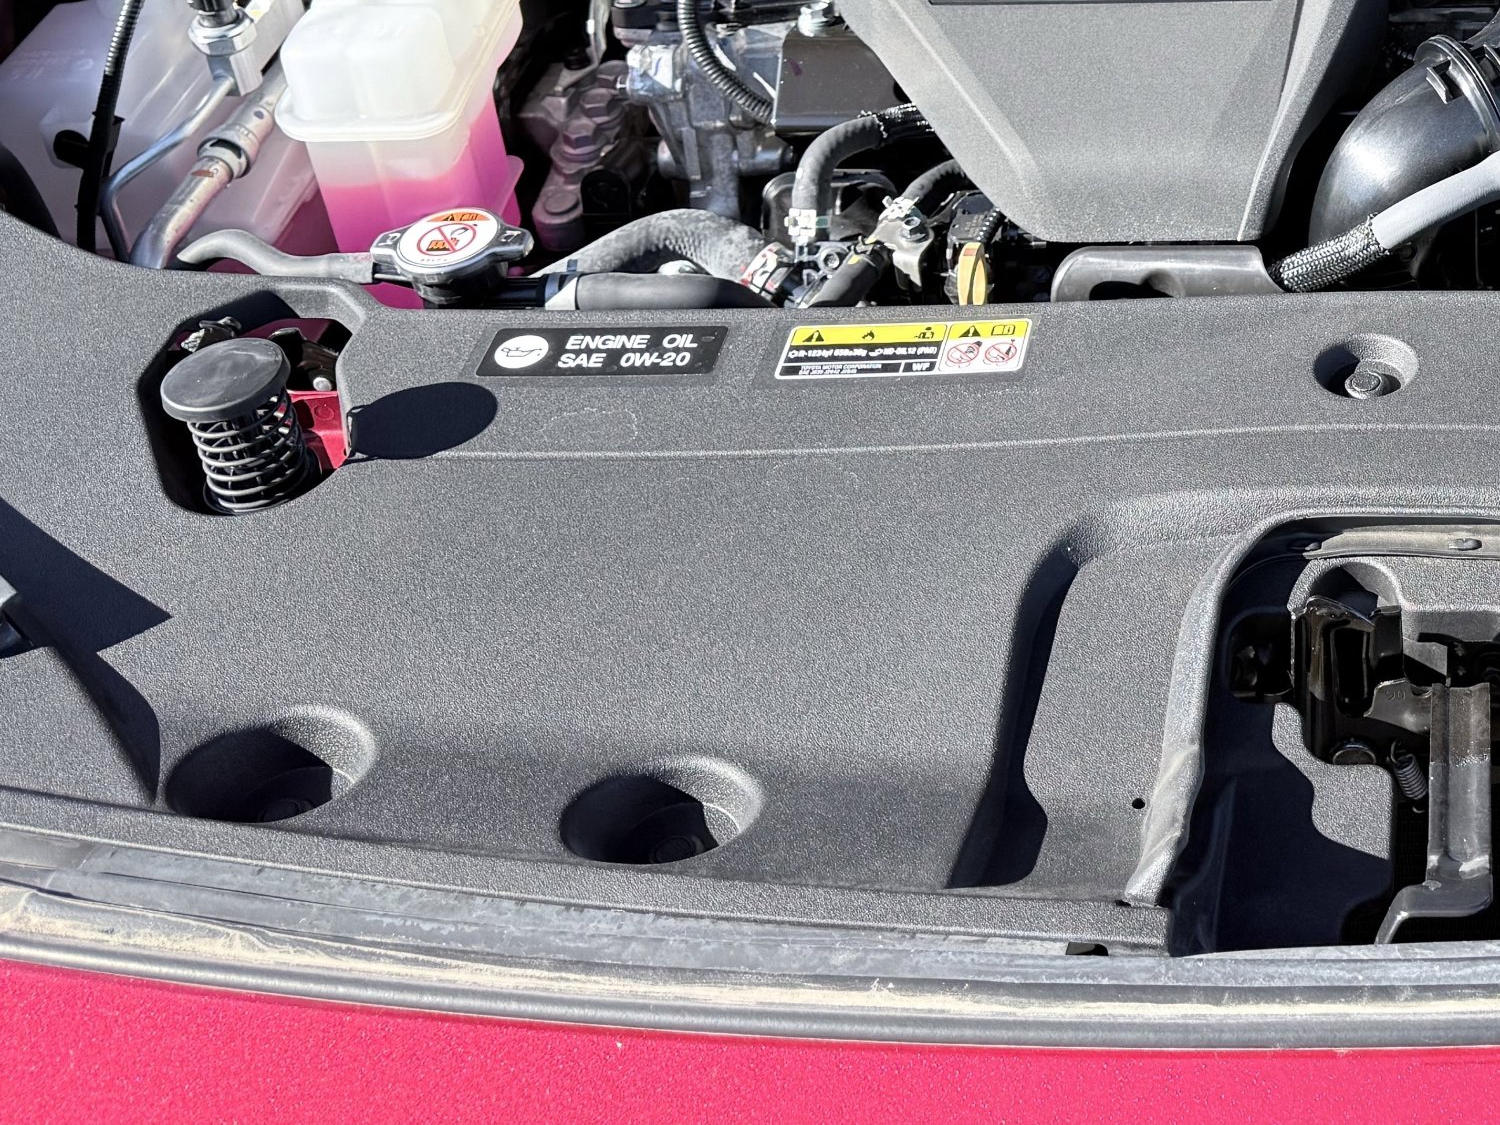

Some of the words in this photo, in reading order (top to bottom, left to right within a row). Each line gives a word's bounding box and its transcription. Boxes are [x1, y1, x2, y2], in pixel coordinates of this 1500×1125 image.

[565, 334, 651, 350] ENGINE
[662, 333, 698, 349] OIL
[557, 353, 606, 368] SAE
[620, 352, 691, 367] 0W-20
